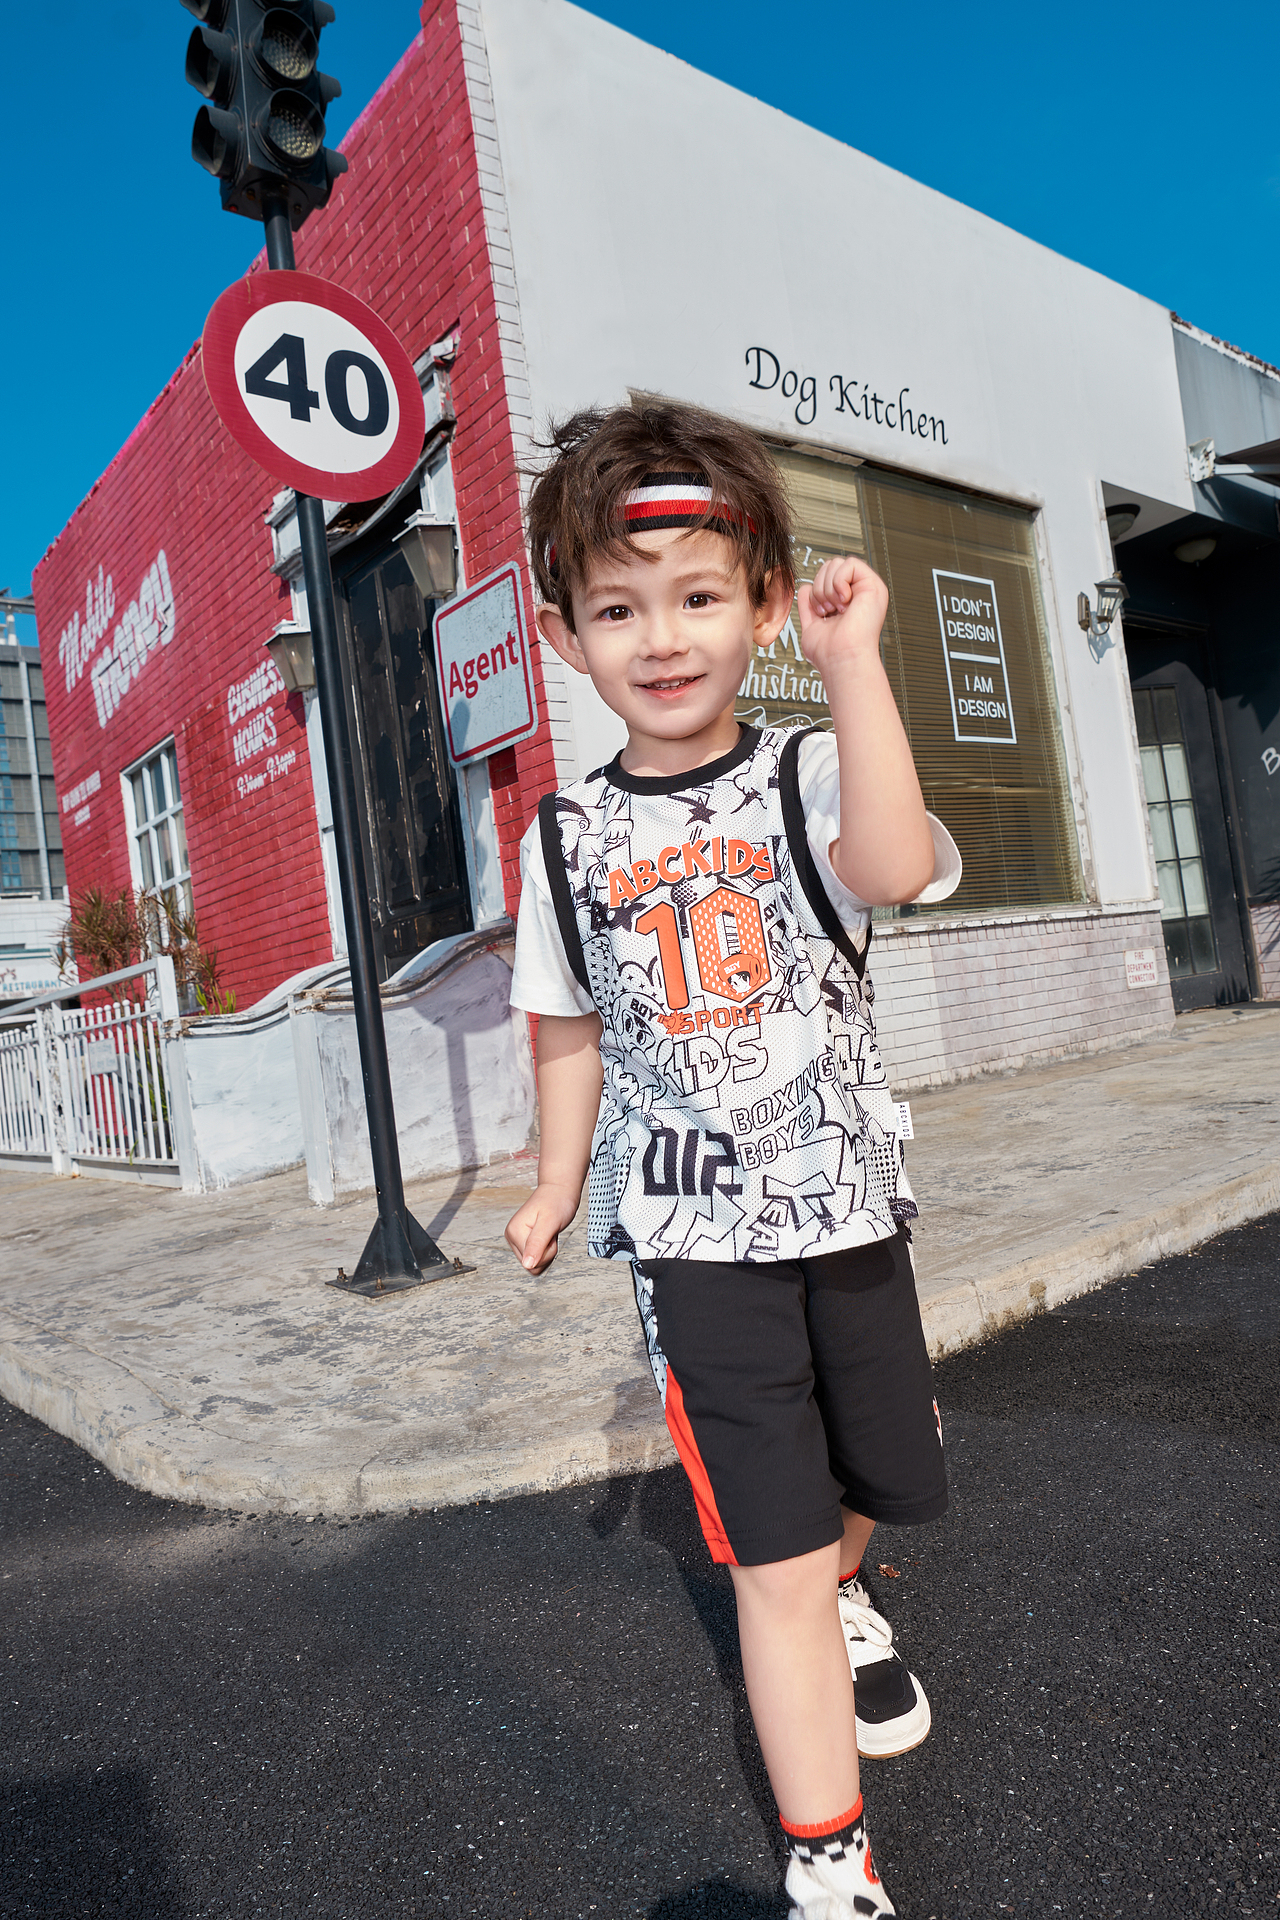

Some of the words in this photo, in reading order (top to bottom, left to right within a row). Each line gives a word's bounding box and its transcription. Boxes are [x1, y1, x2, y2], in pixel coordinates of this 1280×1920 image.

[244, 332, 390, 437] 40
[745, 346, 818, 425] Dog
[829, 374, 949, 445] Kitchen
[59, 564, 116, 694] Mobile
[943, 595, 949, 612] I
[950, 596, 992, 619] DON'T
[946, 620, 996, 643] DESIGN
[449, 630, 519, 699] Agent
[964, 674, 970, 691] I
[973, 675, 994, 694] AM
[233, 706, 277, 767] HOURS
[958, 698, 1007, 719] DESIGN
[607, 835, 776, 909] ABCKIDS
[631, 885, 774, 1011] 10
[630, 997, 660, 1022] BOY
[679, 1002, 764, 1035] SPORT
[730, 1050, 836, 1136] BOXING
[899, 1104, 911, 1138] ABCKIDS
[738, 1105, 815, 1171] BOYS
